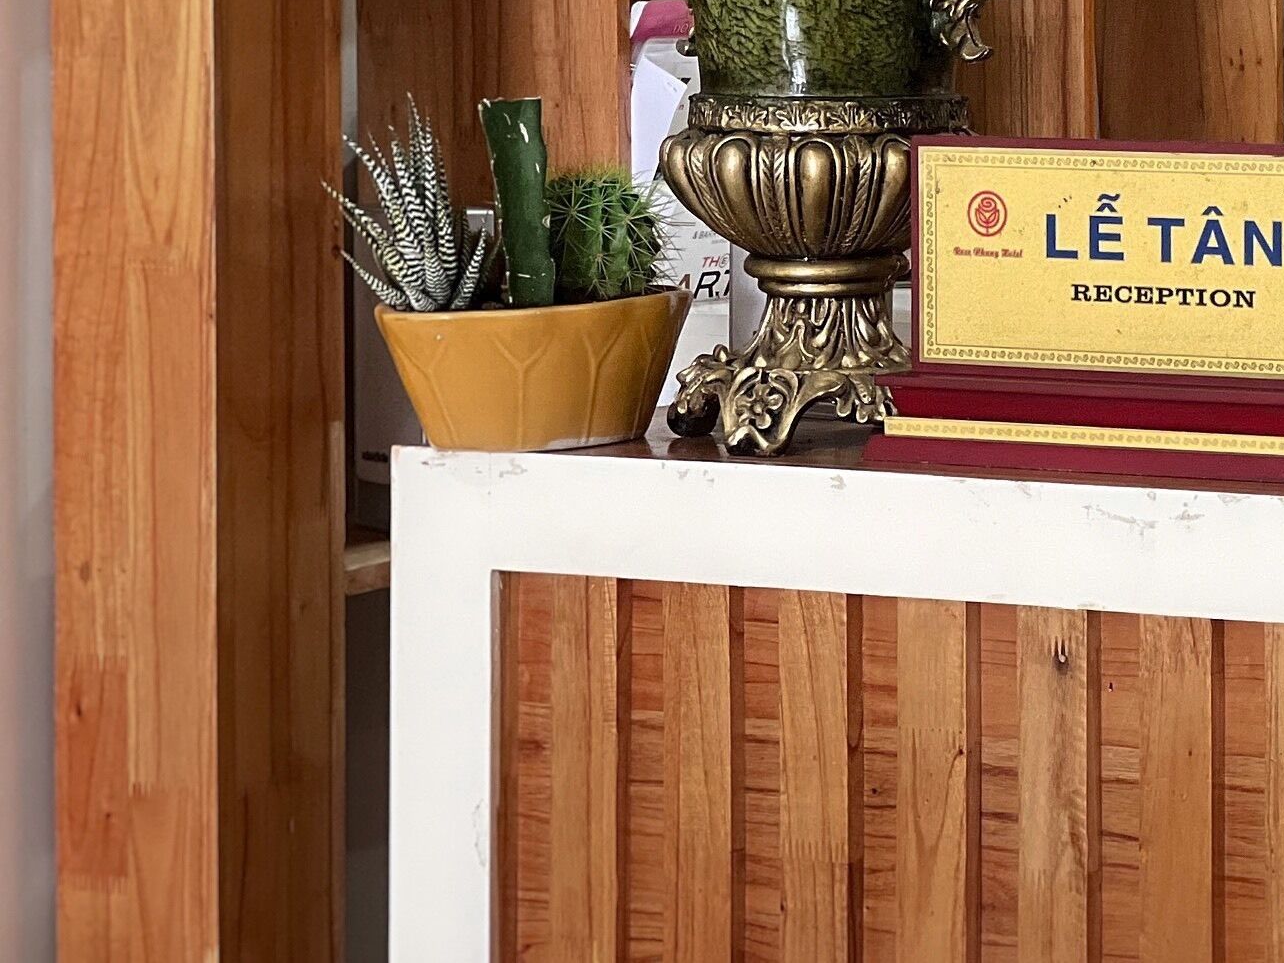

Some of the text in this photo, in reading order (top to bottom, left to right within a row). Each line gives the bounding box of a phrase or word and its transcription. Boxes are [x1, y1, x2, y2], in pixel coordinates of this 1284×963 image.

[1046, 193, 1284, 268] LỄ TÂN
[1071, 283, 1257, 310] RECEPTION
